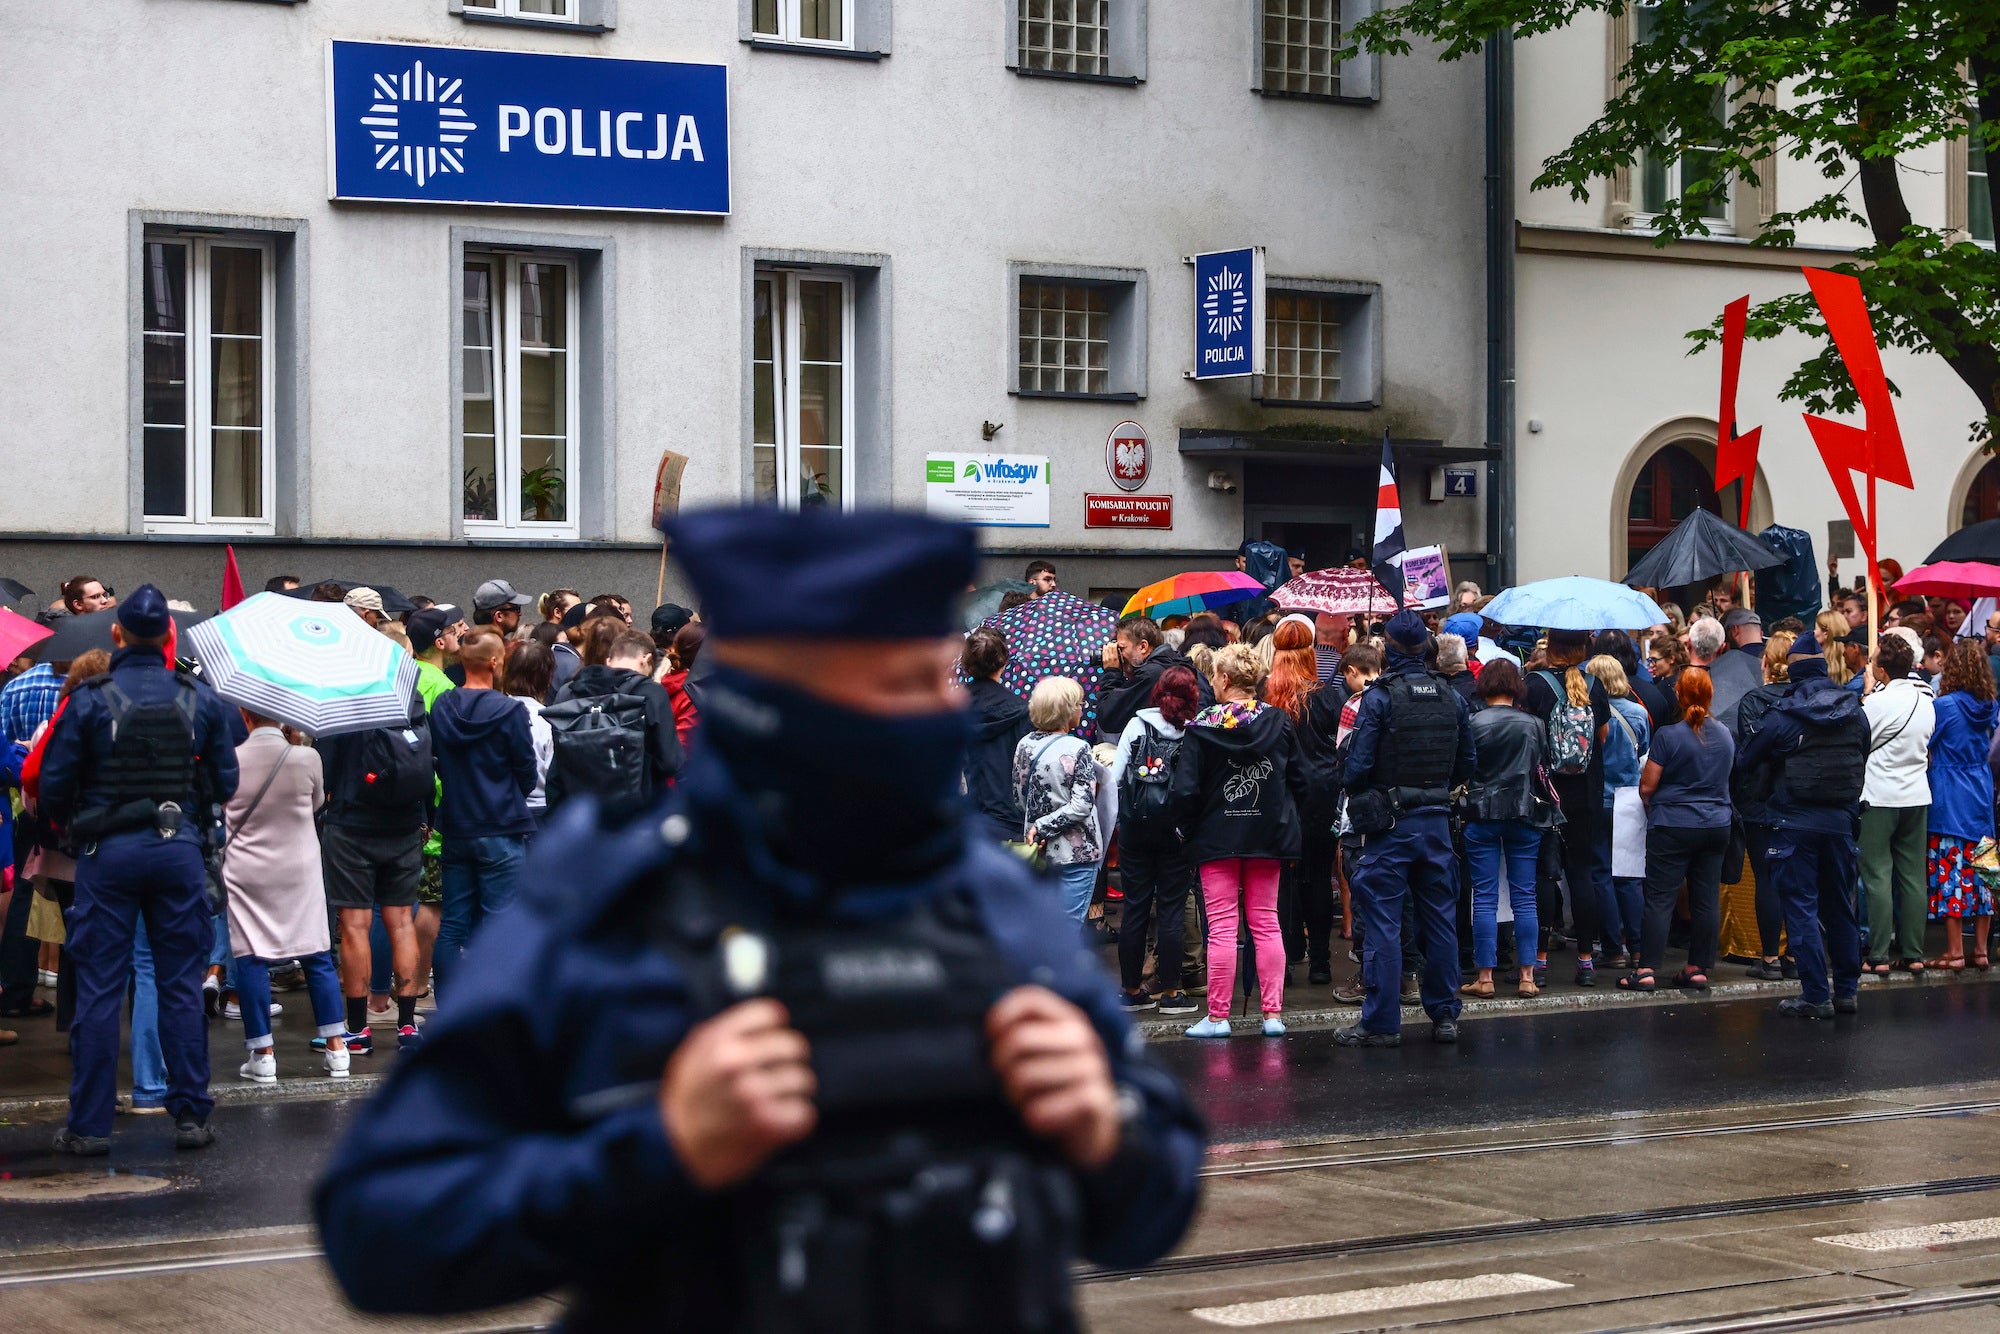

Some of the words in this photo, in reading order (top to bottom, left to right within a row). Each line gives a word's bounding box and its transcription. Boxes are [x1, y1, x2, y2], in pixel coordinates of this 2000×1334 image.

[498, 104, 705, 162] POLICJA
[1205, 346, 1244, 364] POLICJA
[1454, 476, 1467, 494] 4
[1089, 500, 1135, 510] KOMISARIAT
[1136, 501, 1162, 511] POLICJI
[1162, 502, 1169, 511] IV
[1119, 513, 1150, 522] Krakowie
[1413, 686, 1437, 694] POLICJA
